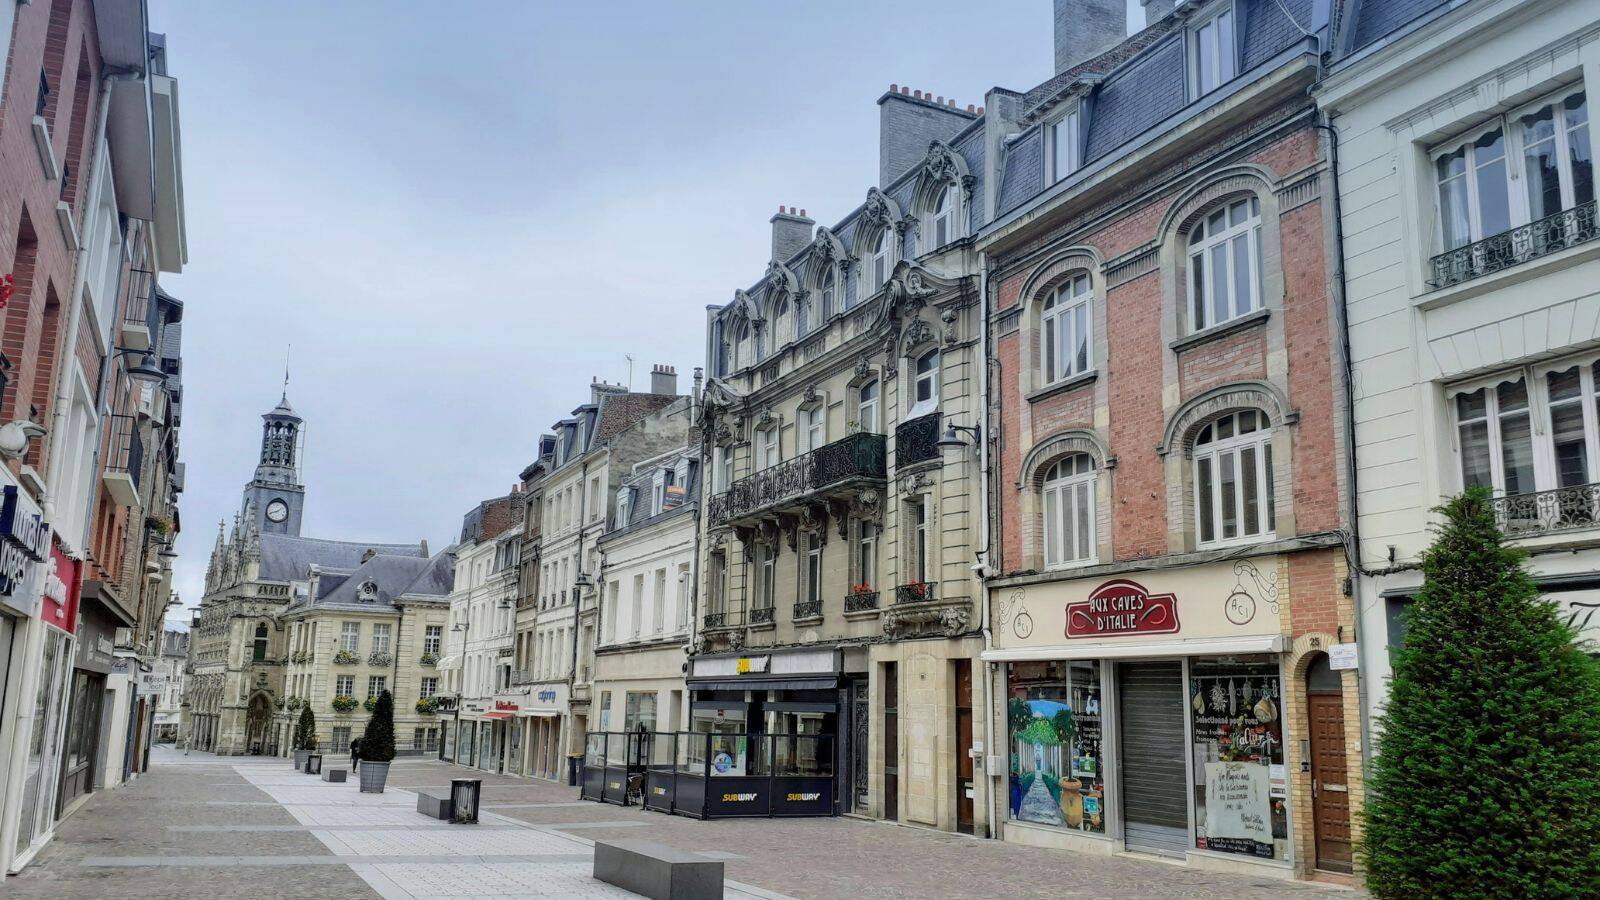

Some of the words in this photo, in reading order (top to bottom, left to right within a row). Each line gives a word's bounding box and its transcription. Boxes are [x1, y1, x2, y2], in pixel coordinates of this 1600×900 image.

[1090, 597, 1108, 613] AUX
[1112, 594, 1143, 611] CAVES
[1097, 613, 1136, 631] D'ITALIE
[736, 655, 768, 674] SUBWAY
[722, 793, 757, 801] SUBWAY
